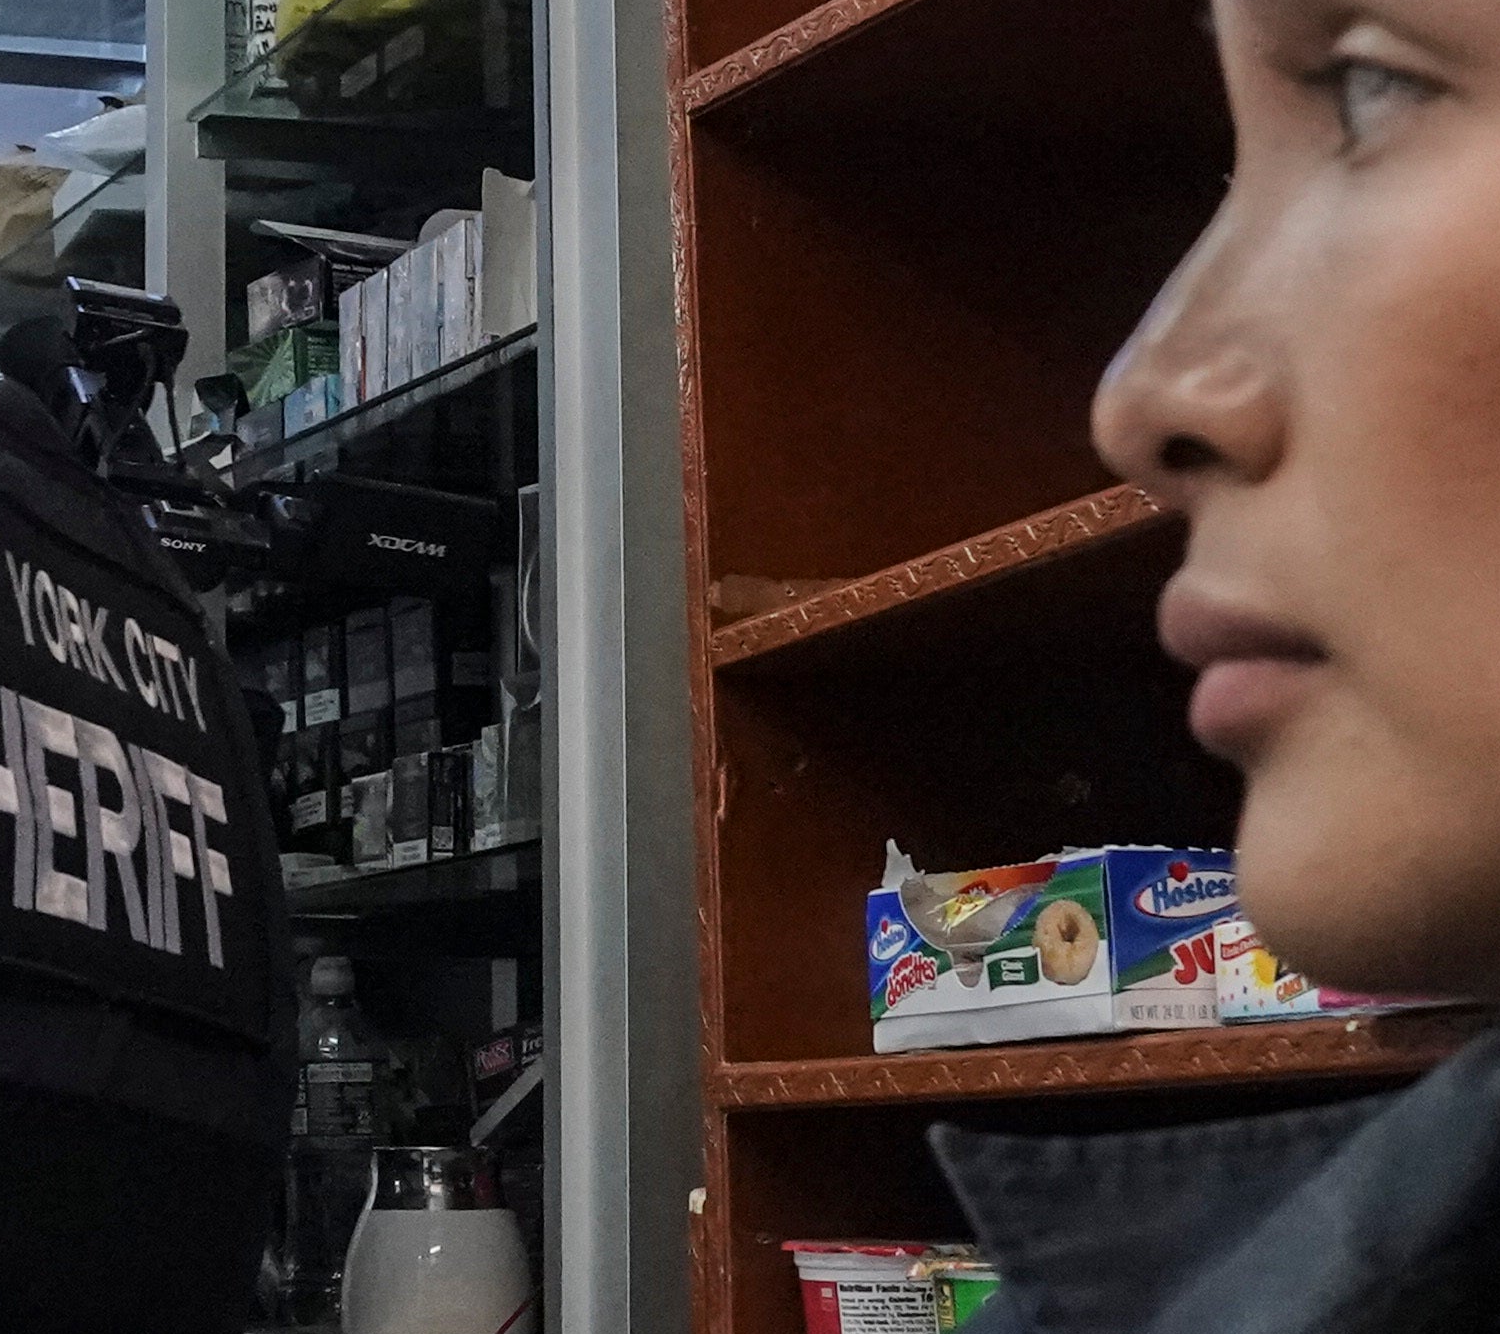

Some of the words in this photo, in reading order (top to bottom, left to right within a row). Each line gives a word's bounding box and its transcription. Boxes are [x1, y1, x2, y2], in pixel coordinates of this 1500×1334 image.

[160, 536, 207, 553] SONY
[367, 532, 448, 558] XDCAM
[5, 550, 127, 692] YORK
[125, 616, 207, 733] CITY
[1129, 1003, 1145, 1019] NET
[876, 1283, 900, 1294] Facts
